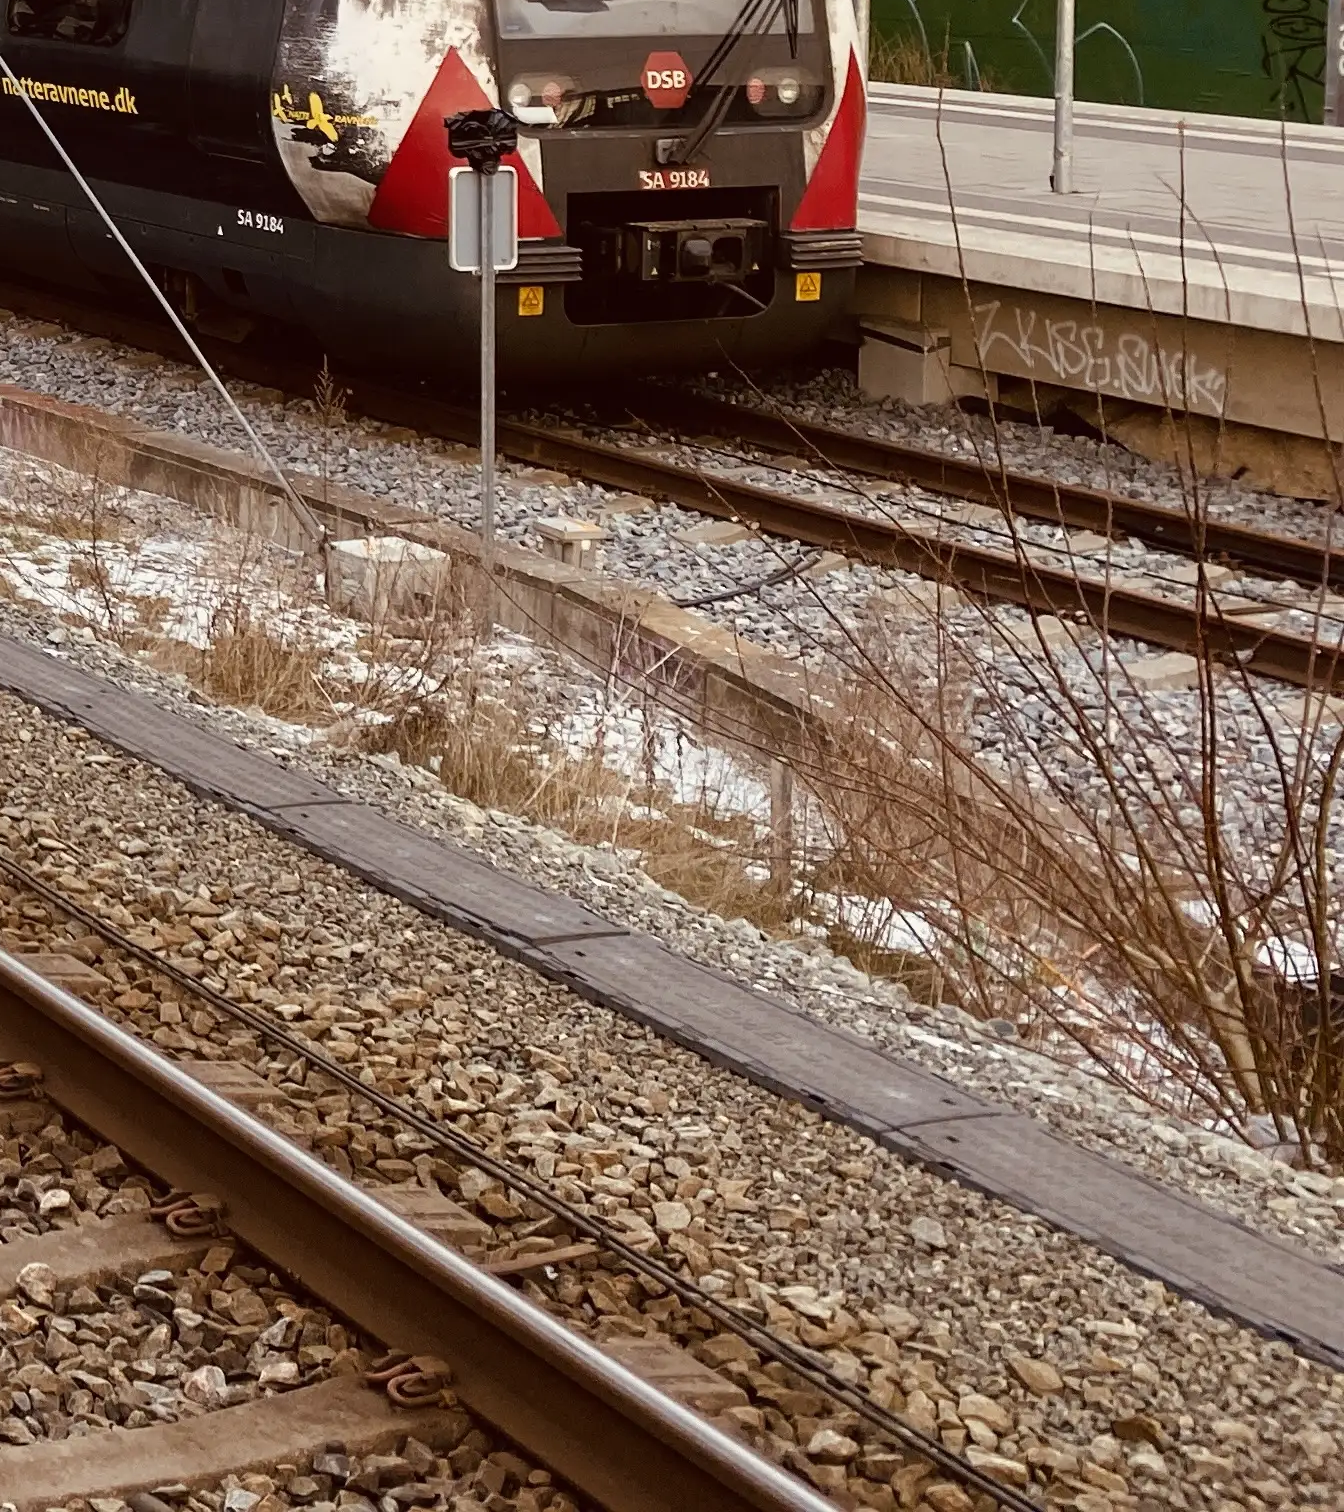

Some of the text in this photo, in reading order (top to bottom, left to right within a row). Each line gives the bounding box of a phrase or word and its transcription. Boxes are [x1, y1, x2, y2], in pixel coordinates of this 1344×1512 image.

[646, 71, 686, 89] DSB
[641, 170, 710, 190] SA 9184
[237, 209, 284, 234] SA 9184
